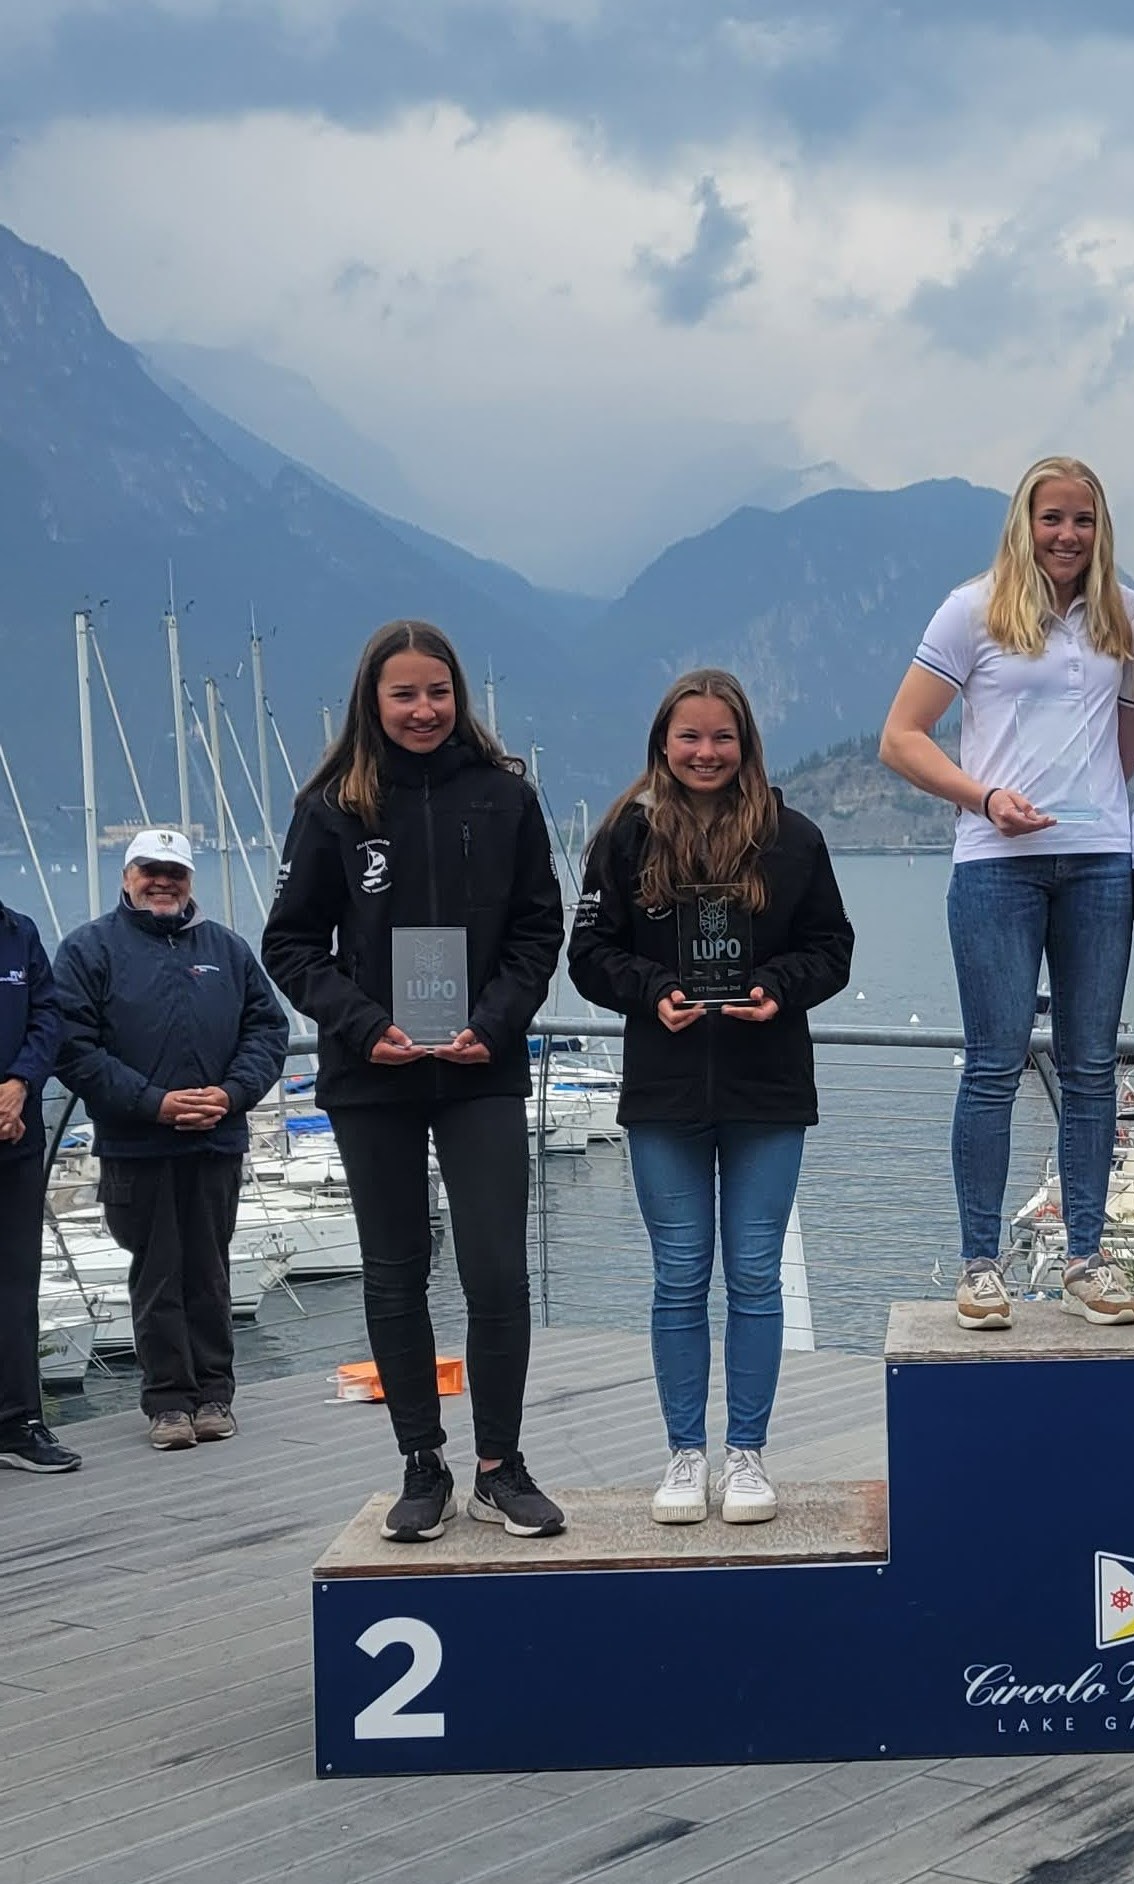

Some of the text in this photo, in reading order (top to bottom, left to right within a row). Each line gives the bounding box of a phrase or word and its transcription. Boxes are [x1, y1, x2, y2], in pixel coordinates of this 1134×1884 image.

[692, 938, 741, 961] LUPO
[406, 979, 457, 1000] LUPO
[354, 1617, 446, 1740] 2
[963, 1662, 1110, 1707] Circolo
[998, 1717, 1075, 1733] LAKE
